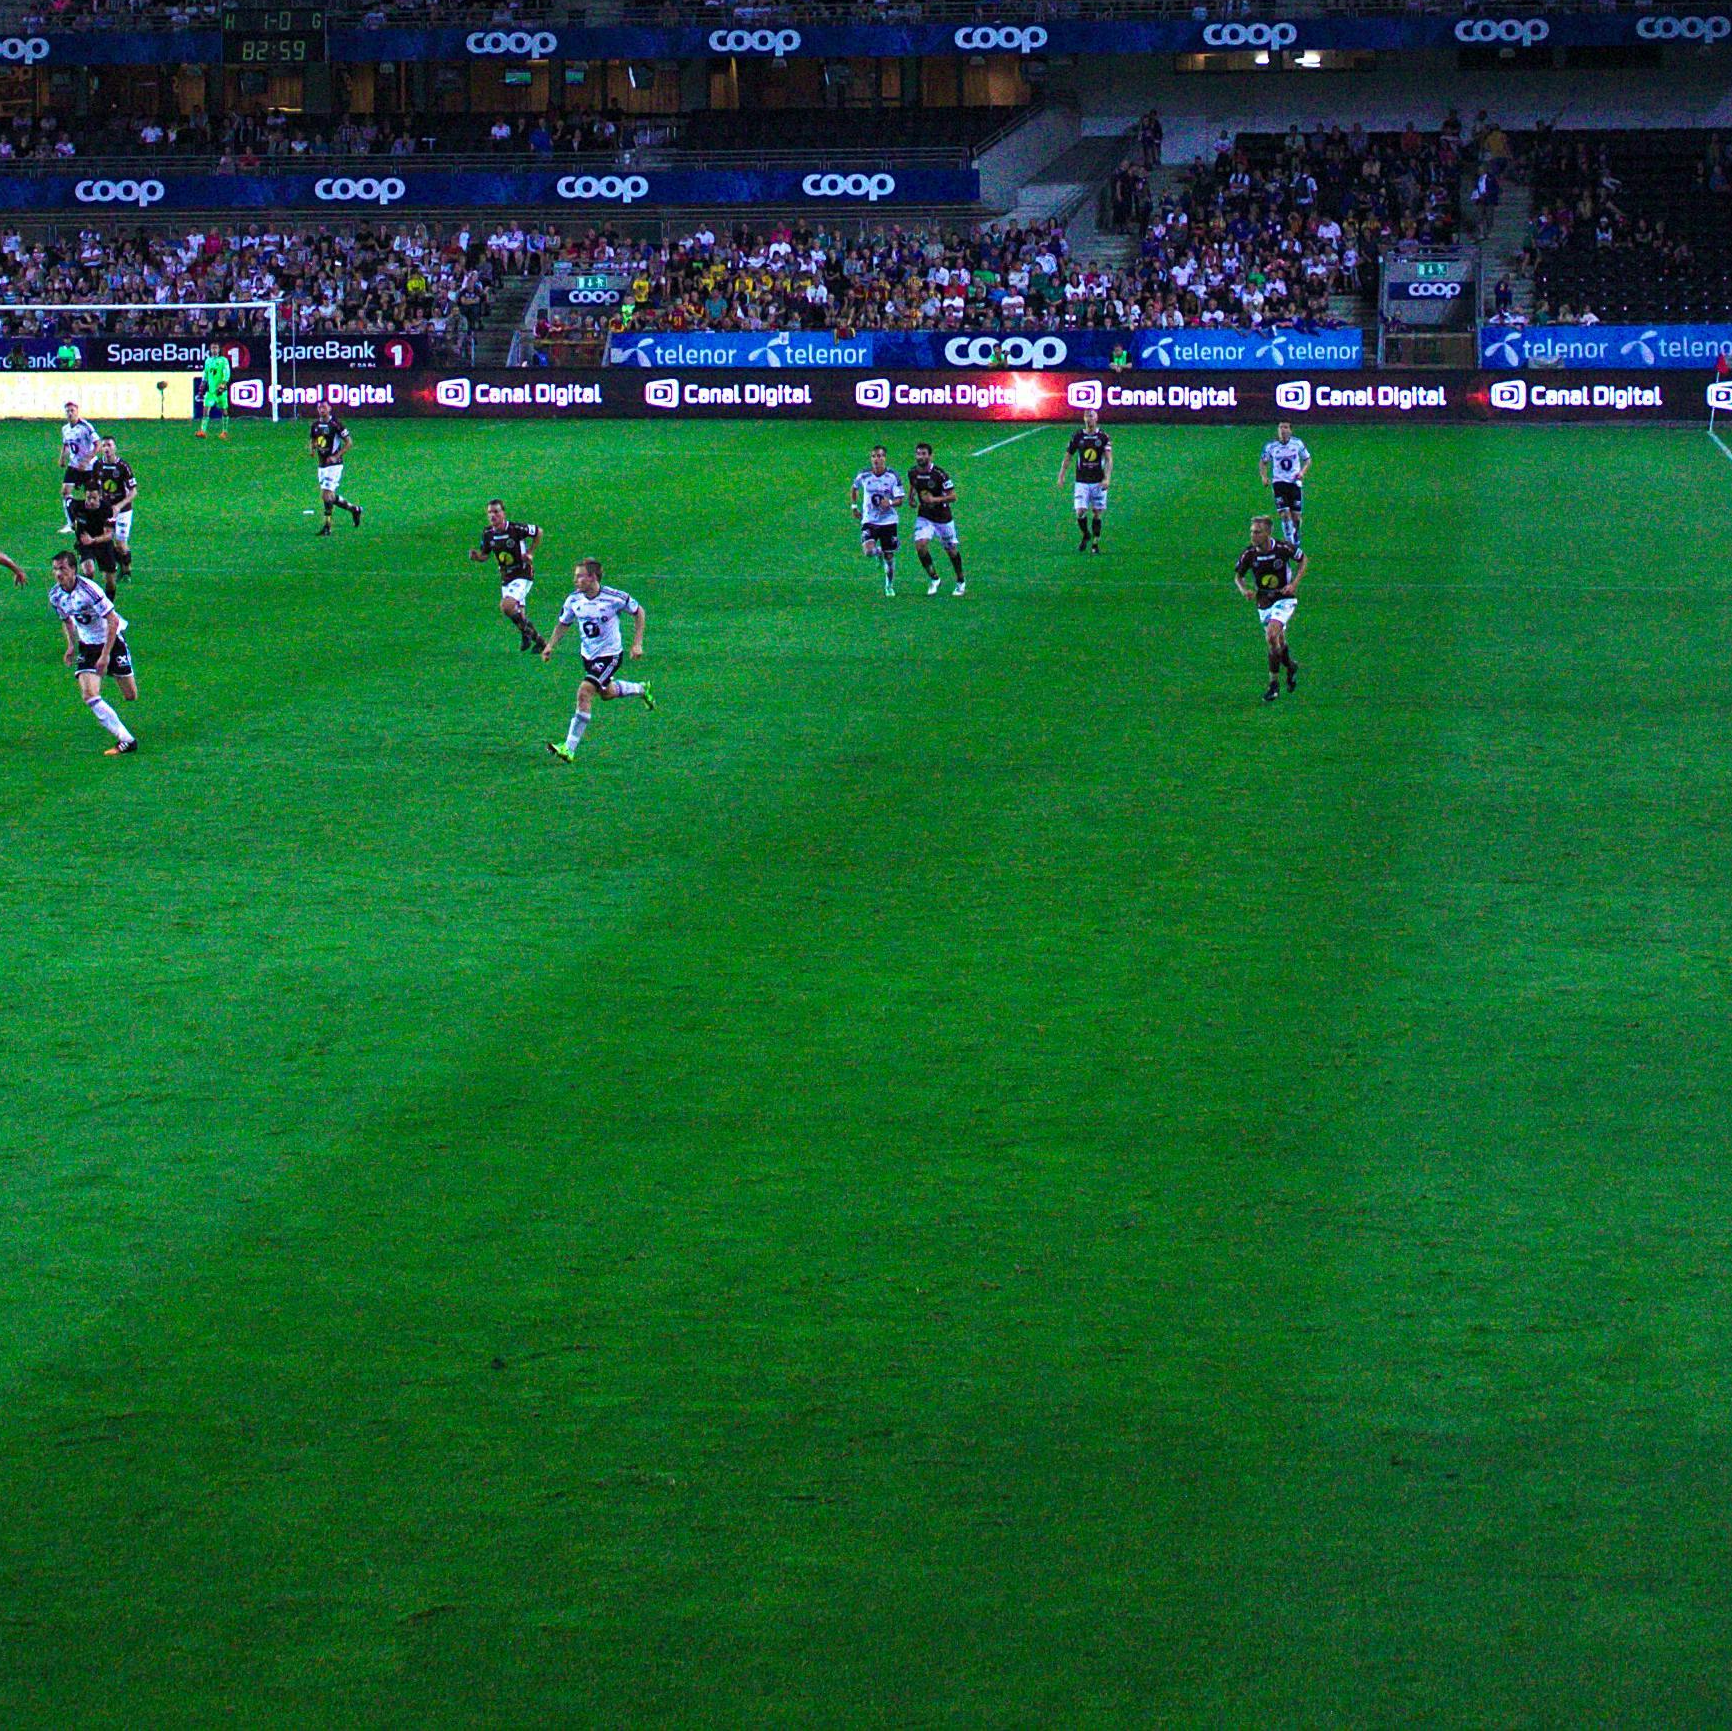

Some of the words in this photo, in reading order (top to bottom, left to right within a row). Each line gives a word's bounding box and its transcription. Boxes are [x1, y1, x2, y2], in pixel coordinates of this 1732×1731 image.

[955, 27, 1047, 53] coop
[1203, 22, 1298, 50] coop
[1455, 19, 1549, 46] coop
[1636, 16, 1730, 43] coop
[243, 41, 305, 61] 82:59
[467, 32, 557, 62] coop
[709, 30, 801, 56] coop
[75, 181, 164, 207] coop
[315, 178, 405, 205] coop
[557, 176, 648, 203] coop
[803, 174, 895, 201] coop
[568, 289, 619, 306] coop
[1409, 279, 1460, 298] coop
[391, 345, 402, 365] 1
[655, 338, 737, 365] telenor
[786, 339, 868, 366] telenor
[1173, 339, 1246, 363] telenor
[1288, 339, 1360, 362] telenor
[1522, 337, 1608, 361] telenor
[327, 384, 395, 407] Digital
[475, 384, 532, 404] Canal
[537, 382, 602, 407] Digital
[684, 383, 742, 405] Canal
[745, 385, 811, 407] Digital
[895, 385, 952, 403] Canal
[955, 384, 1018, 408] Digita
[1107, 387, 1165, 405] Canal
[1169, 387, 1237, 409] Digital
[1316, 384, 1375, 407] Canal
[1378, 383, 1447, 410] Digital
[1532, 386, 1590, 405] Canal
[1594, 386, 1662, 409] Digital
